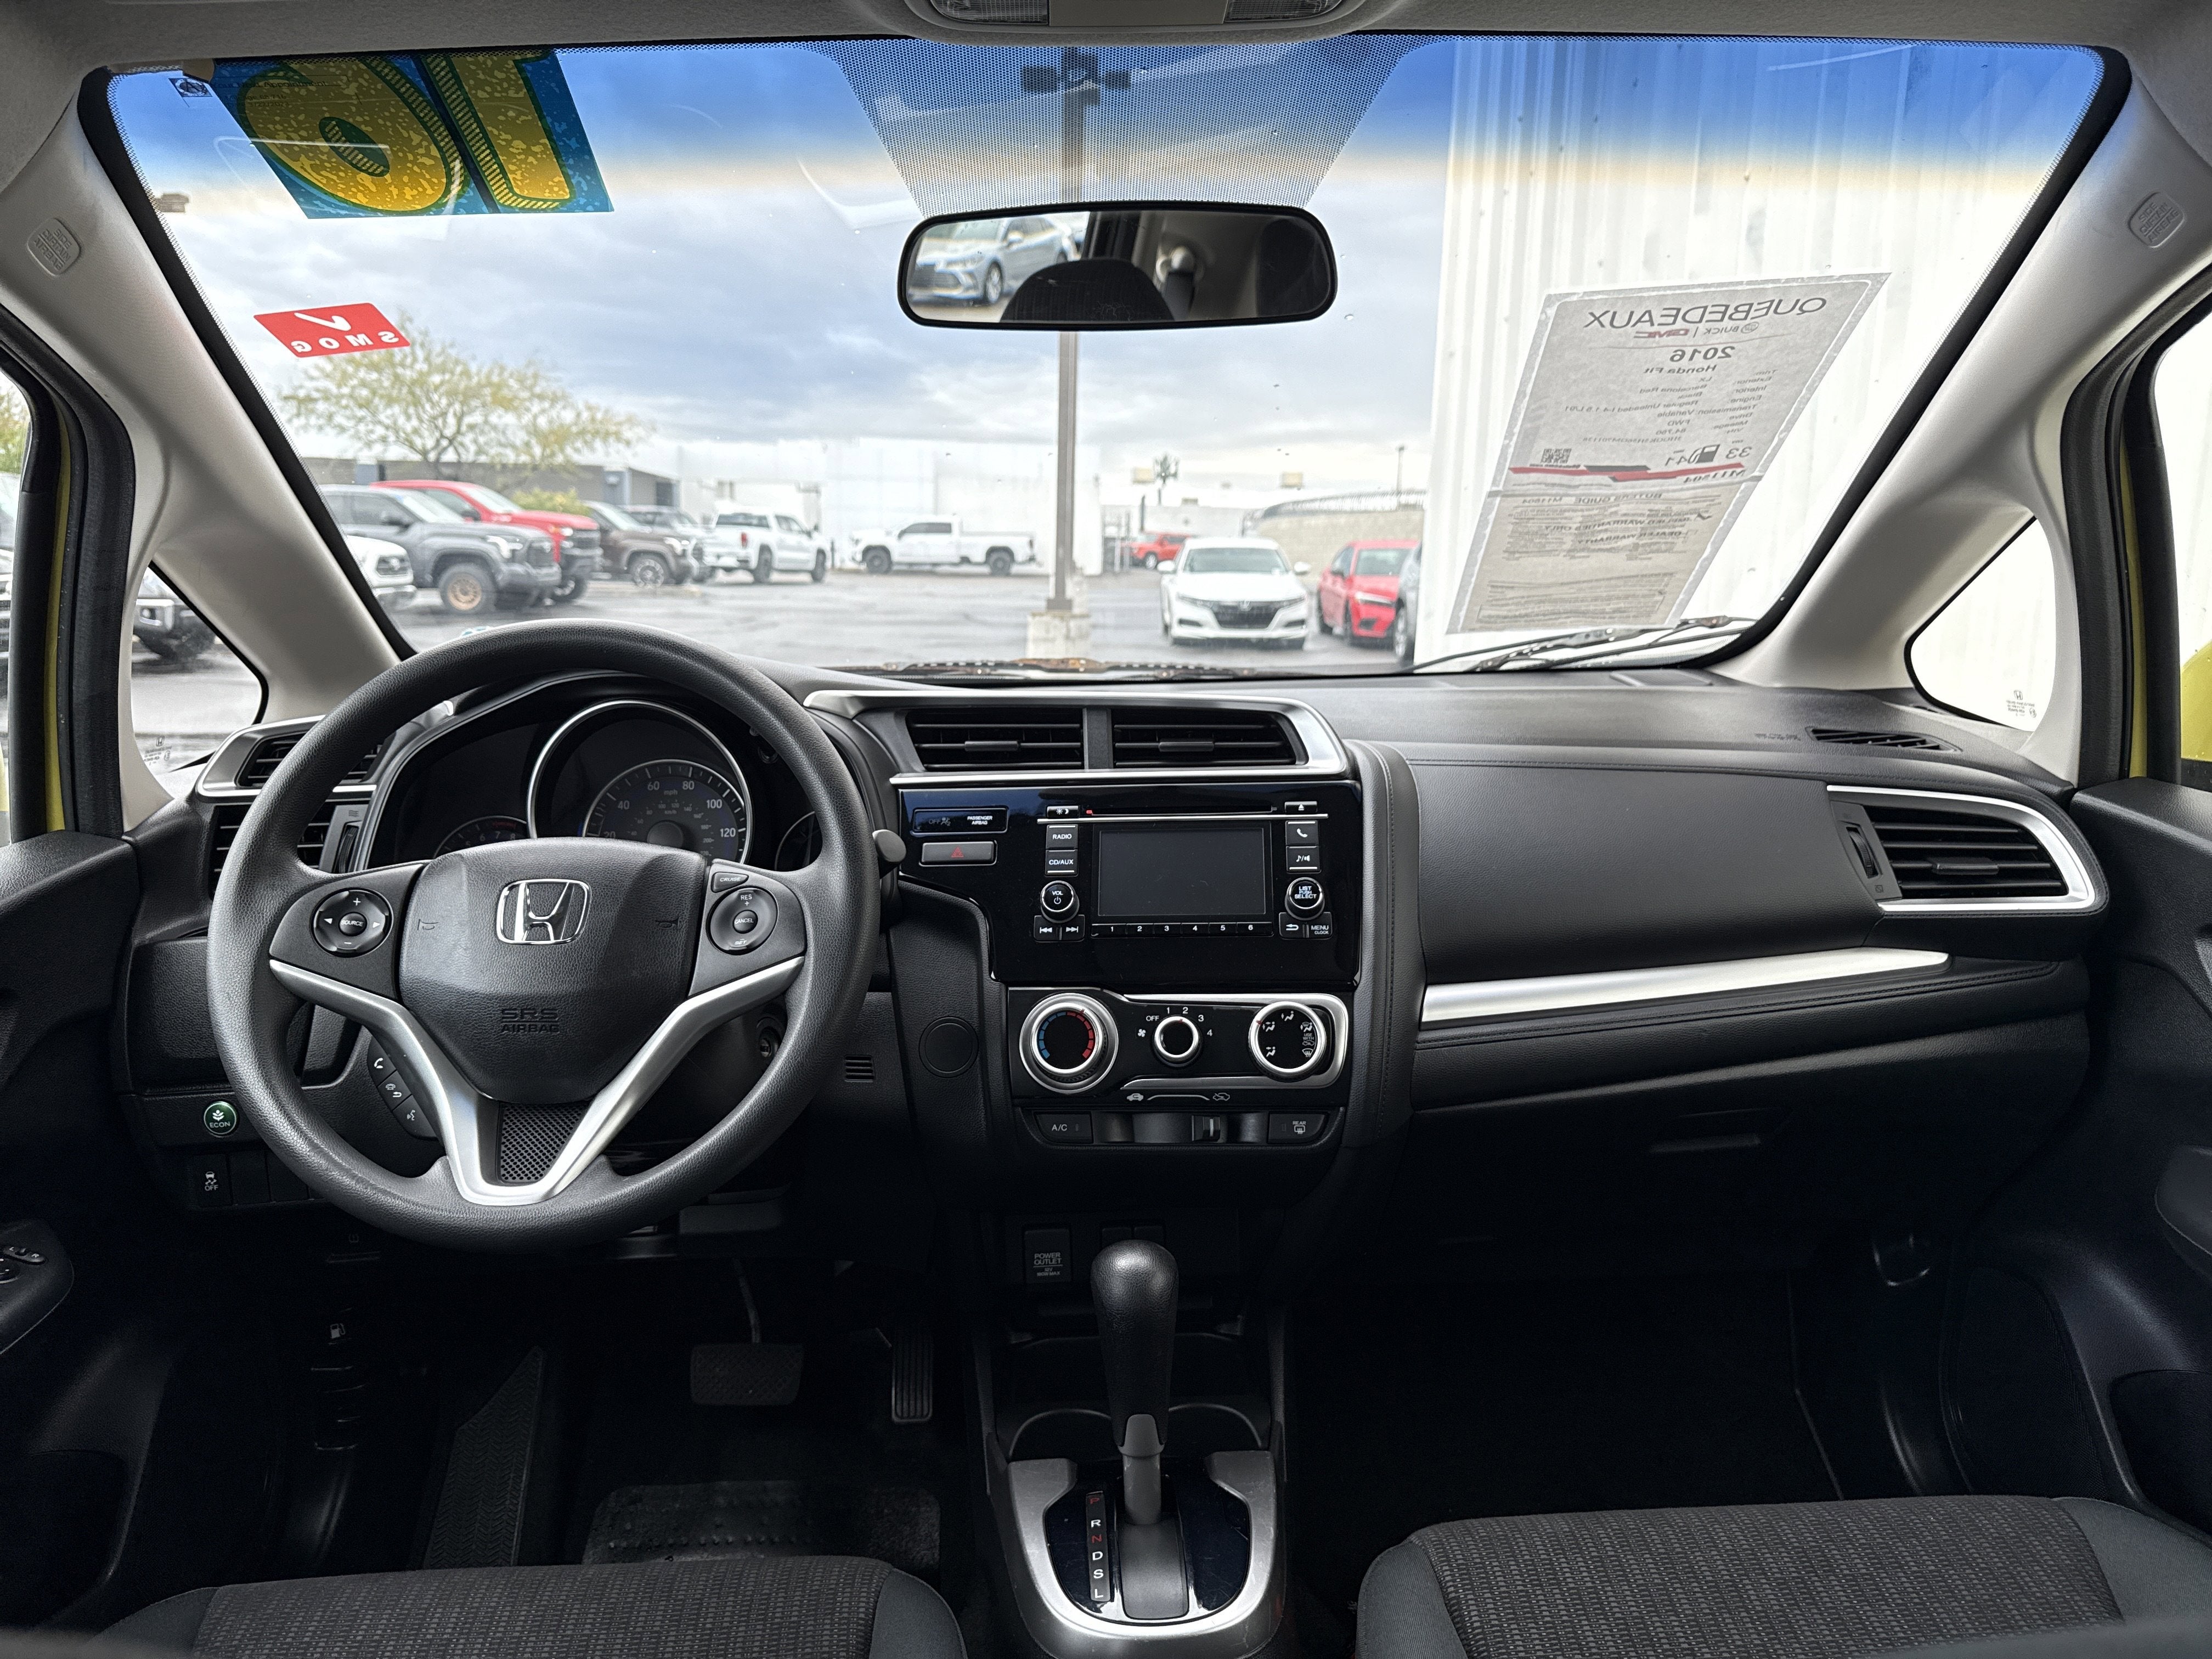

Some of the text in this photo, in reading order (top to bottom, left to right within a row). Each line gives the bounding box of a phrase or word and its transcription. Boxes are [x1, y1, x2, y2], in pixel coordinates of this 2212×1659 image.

[2138, 202, 2157, 222] SIDE
[53, 229, 72, 250] SIDE
[647, 781, 660, 791] 60
[682, 781, 695, 791] 80
[618, 800, 630, 810] 40
[707, 799, 723, 809] 100
[720, 828, 736, 837] 120
[501, 1009, 559, 1020] SRS
[501, 1024, 560, 1032] AIRBAG
[1091, 1519, 1101, 1528] R
[1091, 1534, 1103, 1544] N
[1092, 1551, 1103, 1561] D
[1093, 1568, 1104, 1579] S
[1094, 1588, 1104, 1599] L
